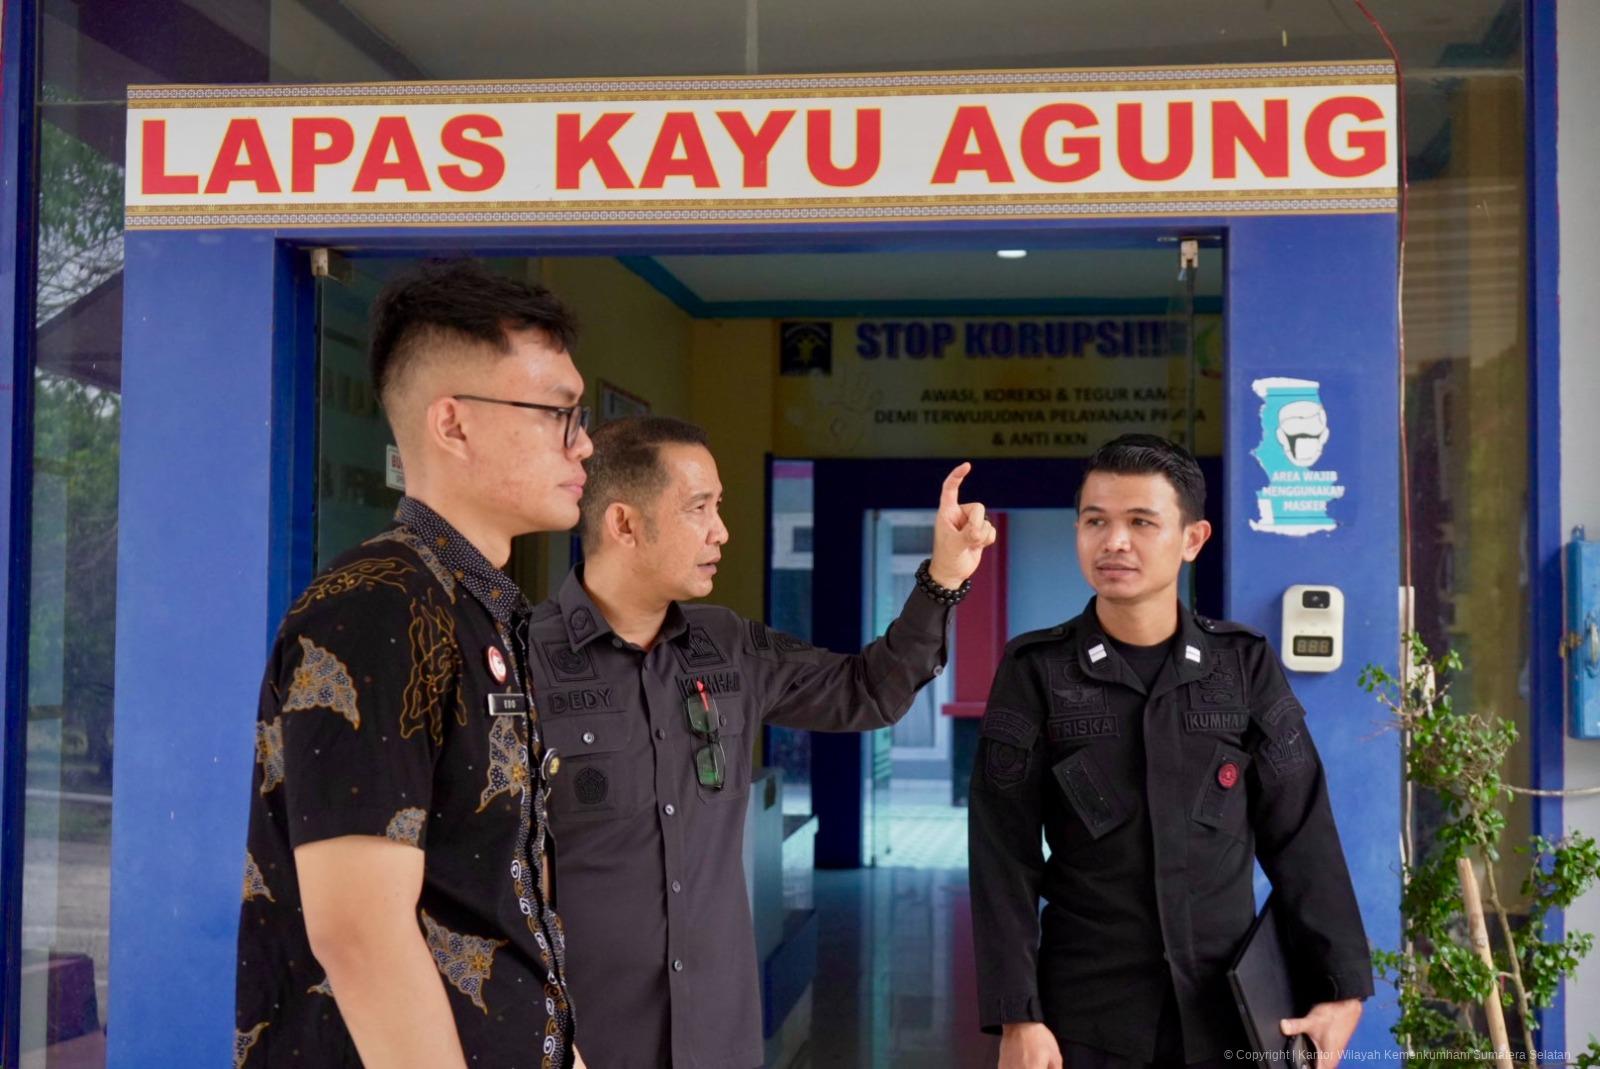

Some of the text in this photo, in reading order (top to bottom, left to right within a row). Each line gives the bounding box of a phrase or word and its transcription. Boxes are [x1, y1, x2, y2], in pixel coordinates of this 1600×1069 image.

[140, 96, 1388, 195] LAPAS KAYU AGUNG
[857, 322, 955, 359] STOP
[921, 388, 978, 404] AWASI,
[983, 388, 1051, 402] KOREKSI
[1056, 388, 1069, 402] &
[1074, 388, 1130, 402] TEGUR
[875, 410, 918, 424] DEMI
[1050, 410, 1145, 423] PELAYANAN
[992, 432, 1088, 446] & ANTI KKN
[1271, 470, 1337, 481] AREA WAJIB
[1283, 500, 1327, 511] MASKER
[547, 687, 611, 715] DEDY
